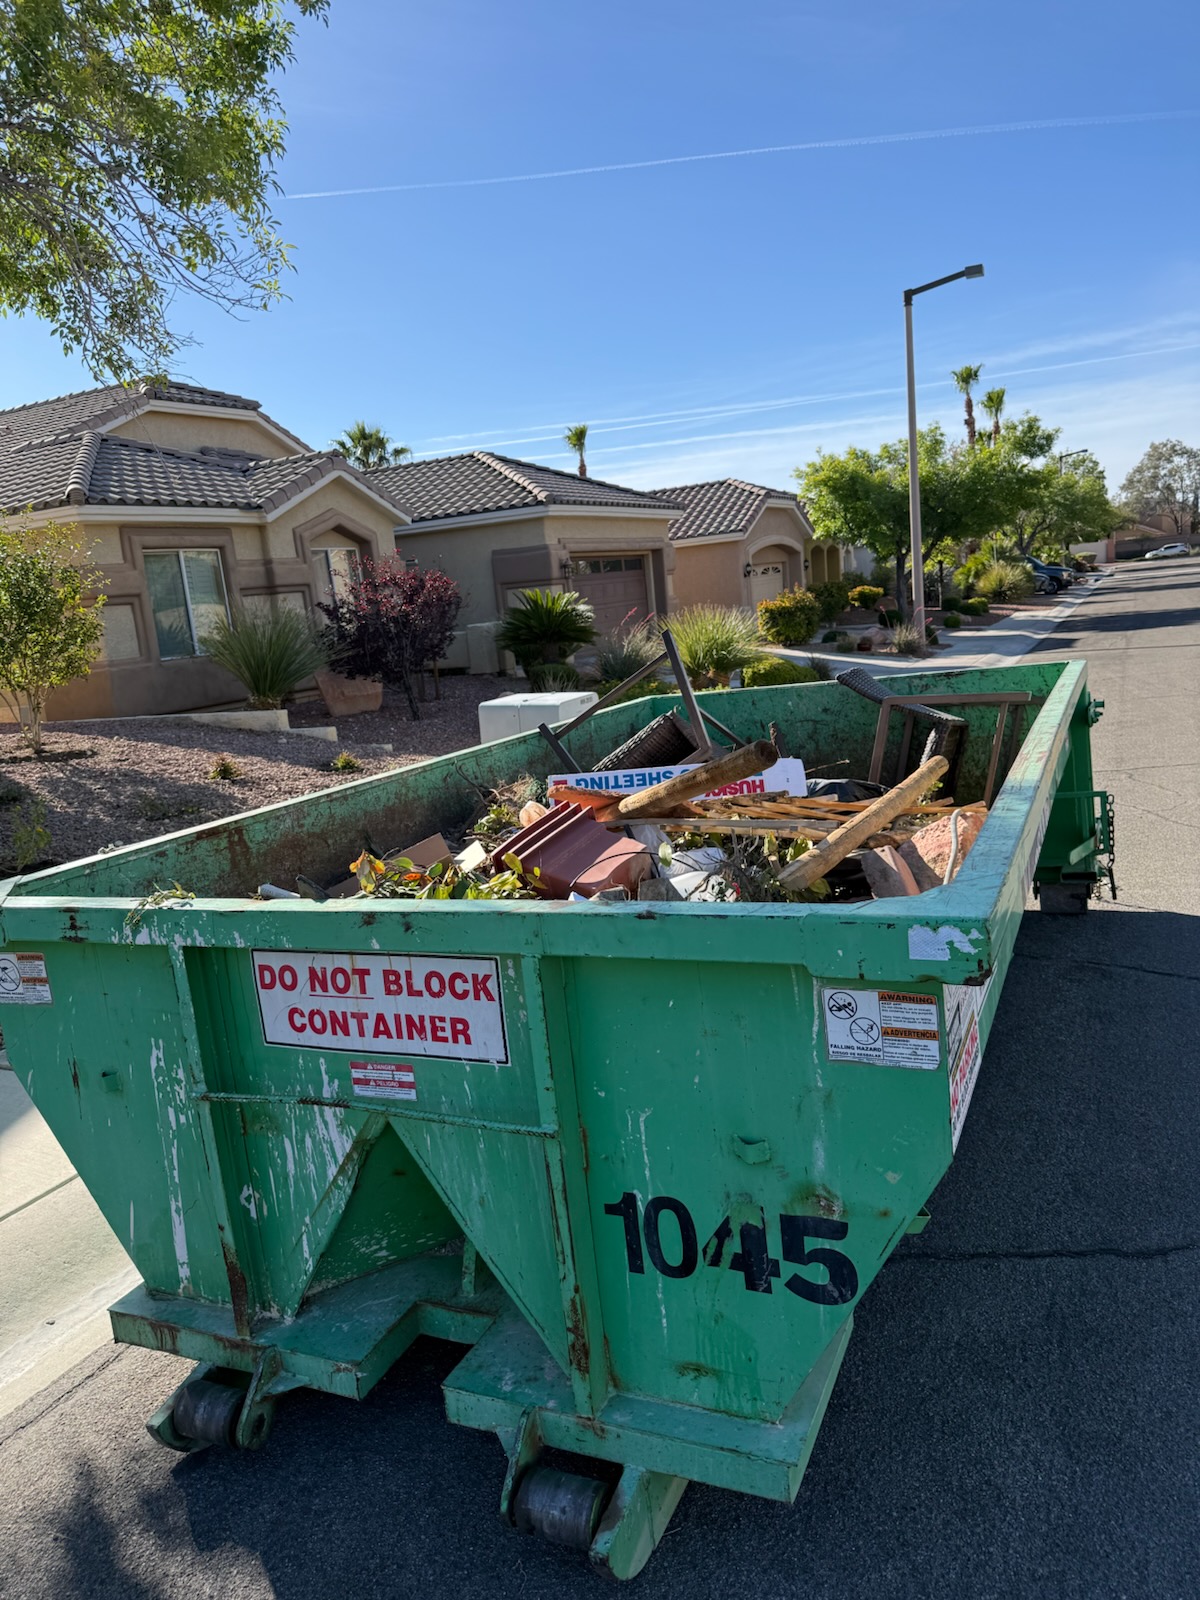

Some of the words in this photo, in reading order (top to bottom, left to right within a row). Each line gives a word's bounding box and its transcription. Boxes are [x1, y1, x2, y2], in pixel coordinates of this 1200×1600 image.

[575, 770, 674, 790] SHEETING
[258, 964, 298, 991] DO
[308, 966, 371, 995] NOT
[382, 969, 496, 1002] BLOCK
[887, 993, 934, 1005] WARNING
[288, 1007, 472, 1045] CONTAINER
[890, 1029, 937, 1039] ADVERTENCIA
[604, 1191, 859, 1306] 1045
